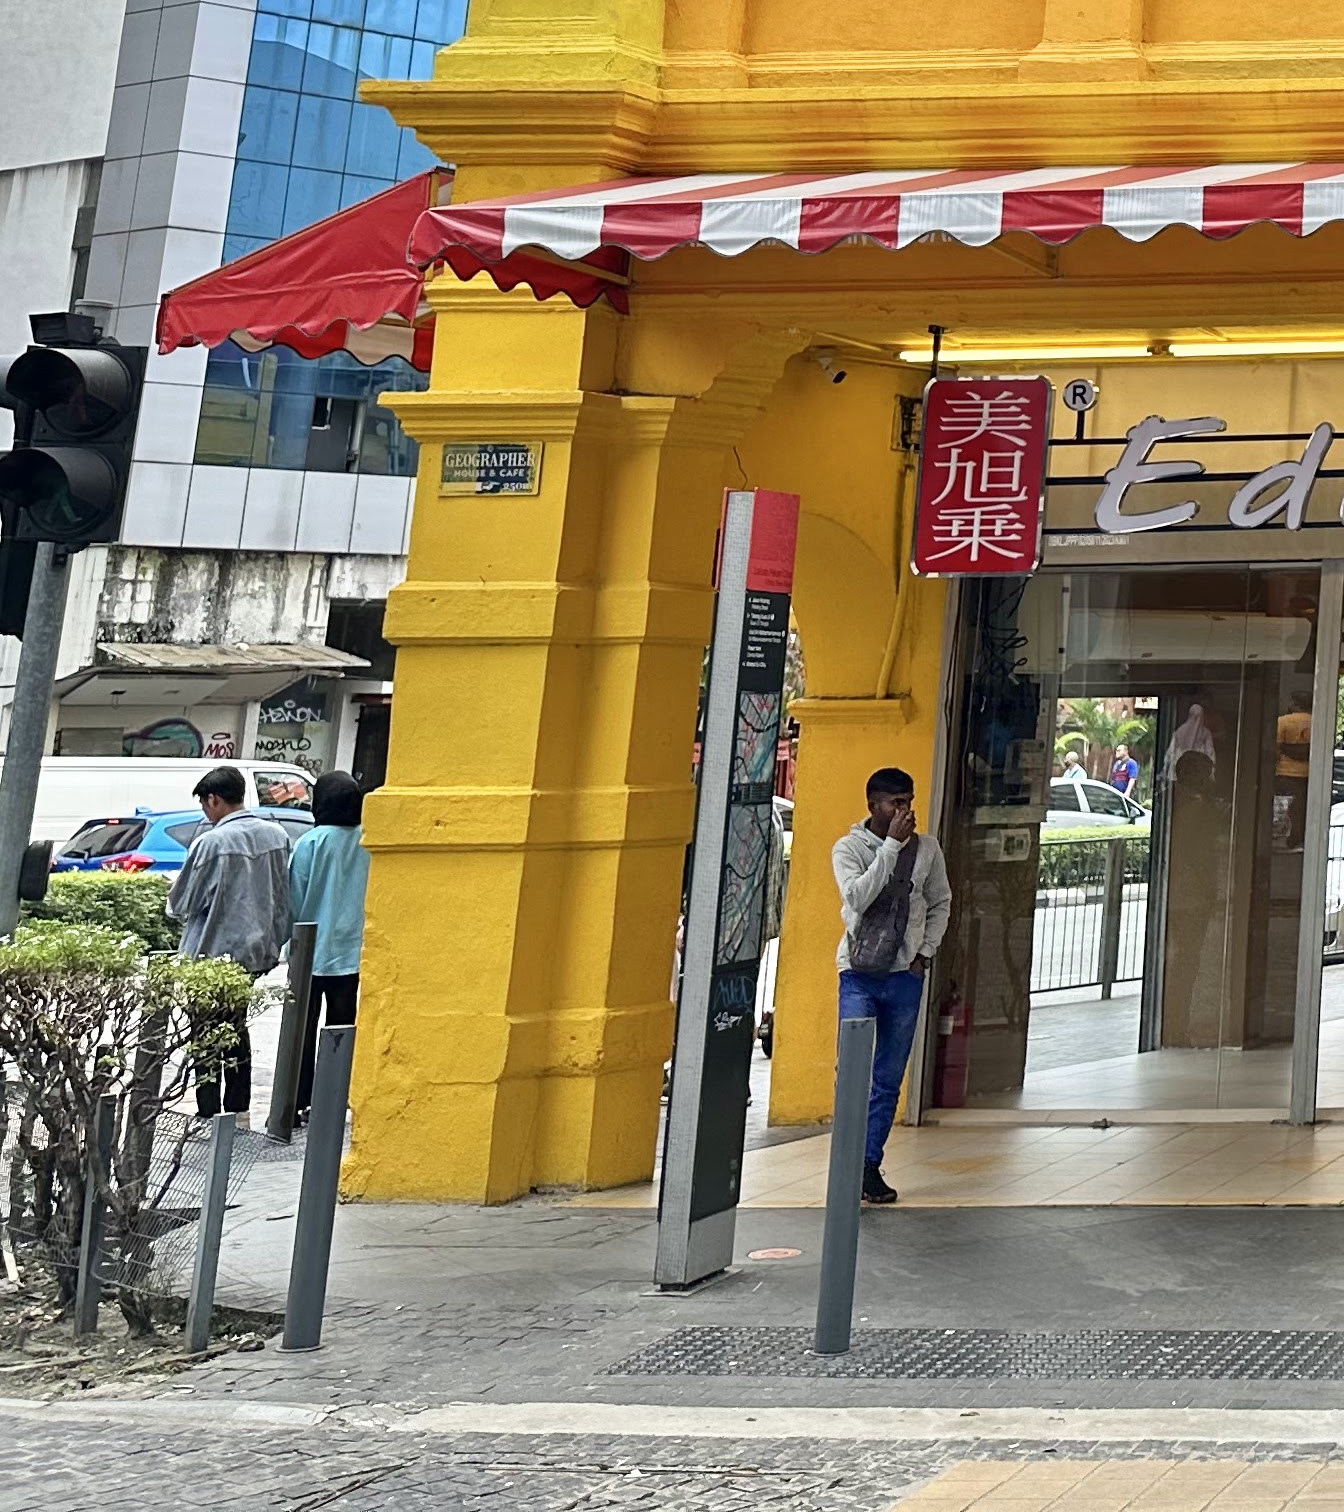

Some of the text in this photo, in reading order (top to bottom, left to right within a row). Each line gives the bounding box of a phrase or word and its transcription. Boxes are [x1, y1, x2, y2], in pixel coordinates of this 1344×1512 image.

[445, 452, 536, 468] GEOGRAPHER
[453, 468, 486, 477] HOUSE
[500, 468, 525, 477] CAFE
